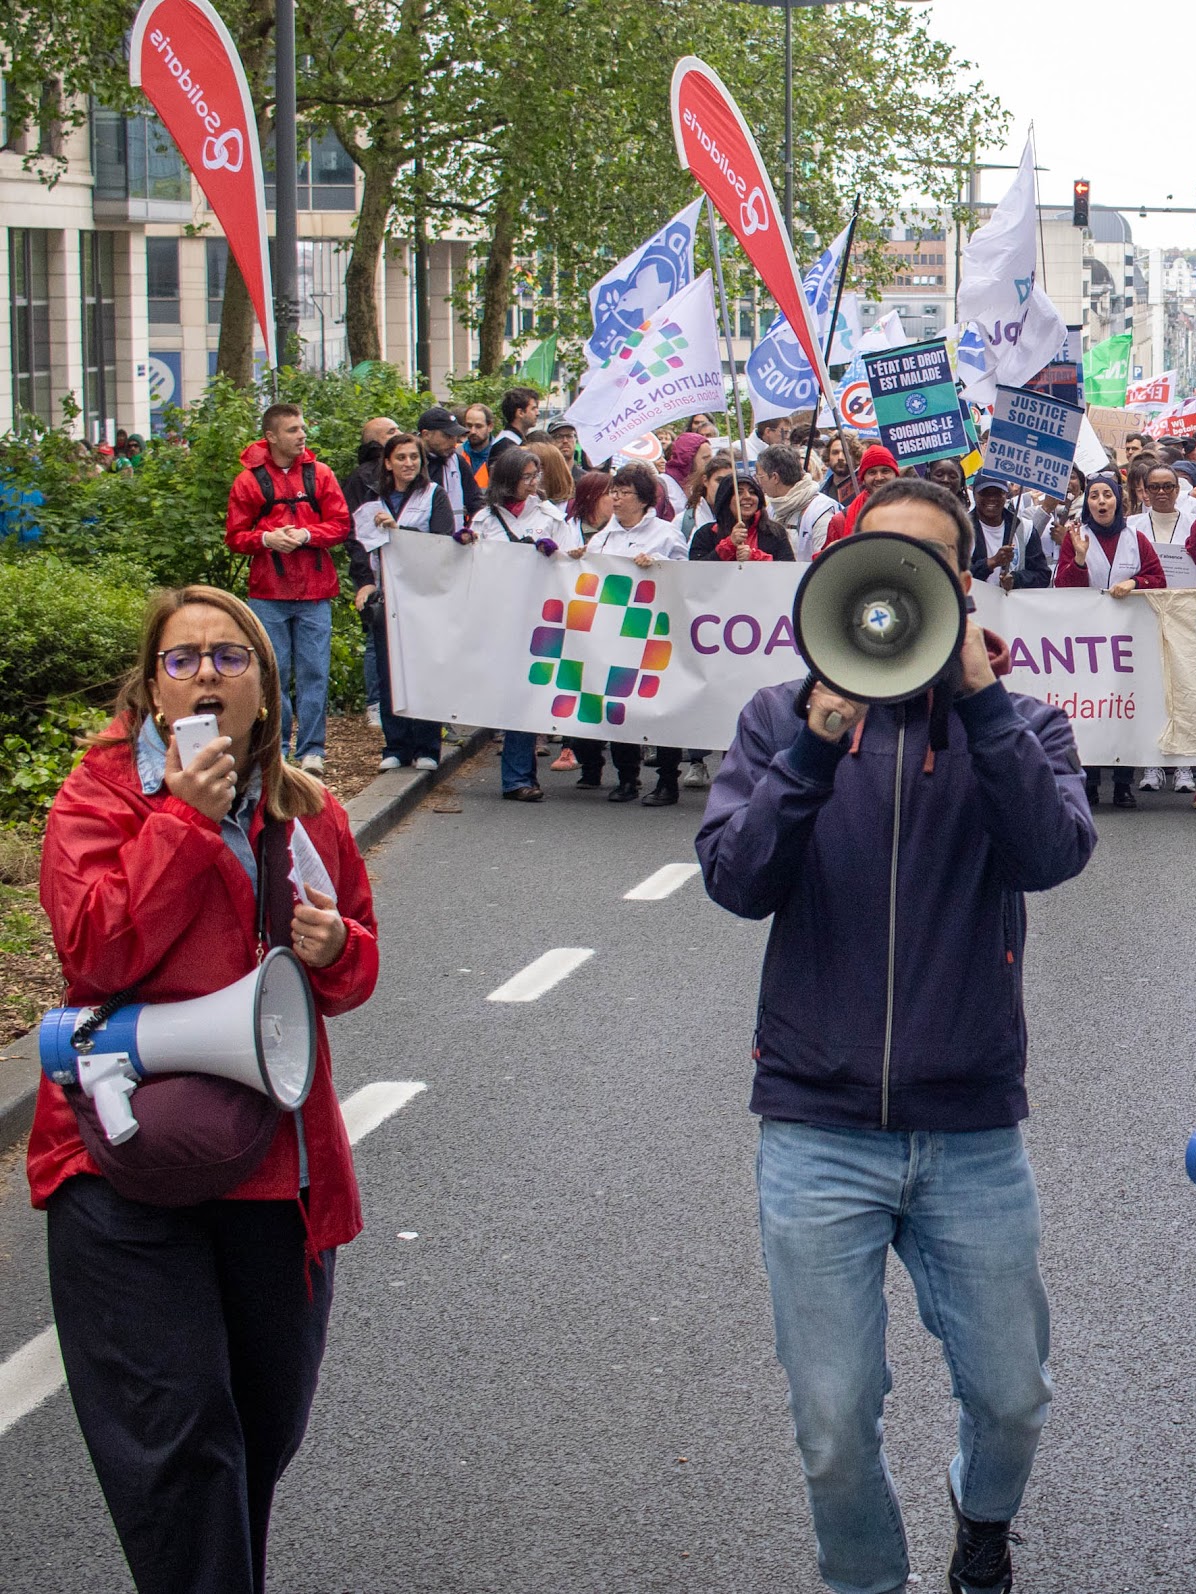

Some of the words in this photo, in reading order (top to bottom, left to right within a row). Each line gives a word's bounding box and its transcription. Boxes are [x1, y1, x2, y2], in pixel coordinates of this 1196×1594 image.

[868, 359, 900, 378] L'ÉTAT
[902, 357, 916, 370] DE
[917, 350, 946, 367] DROIT
[879, 377, 898, 391] EST
[900, 367, 941, 387] MALADE
[1011, 396, 1067, 422] JUSTICE
[889, 416, 954, 441] SOIGNONS-LE
[1008, 409, 1065, 437] SOCIALE
[896, 432, 952, 455] ENSEMBLE!
[989, 441, 1030, 464] SANTÉ
[1035, 456, 1069, 477] POUR
[690, 613, 801, 656] COA
[1009, 635, 1134, 675] ANTE
